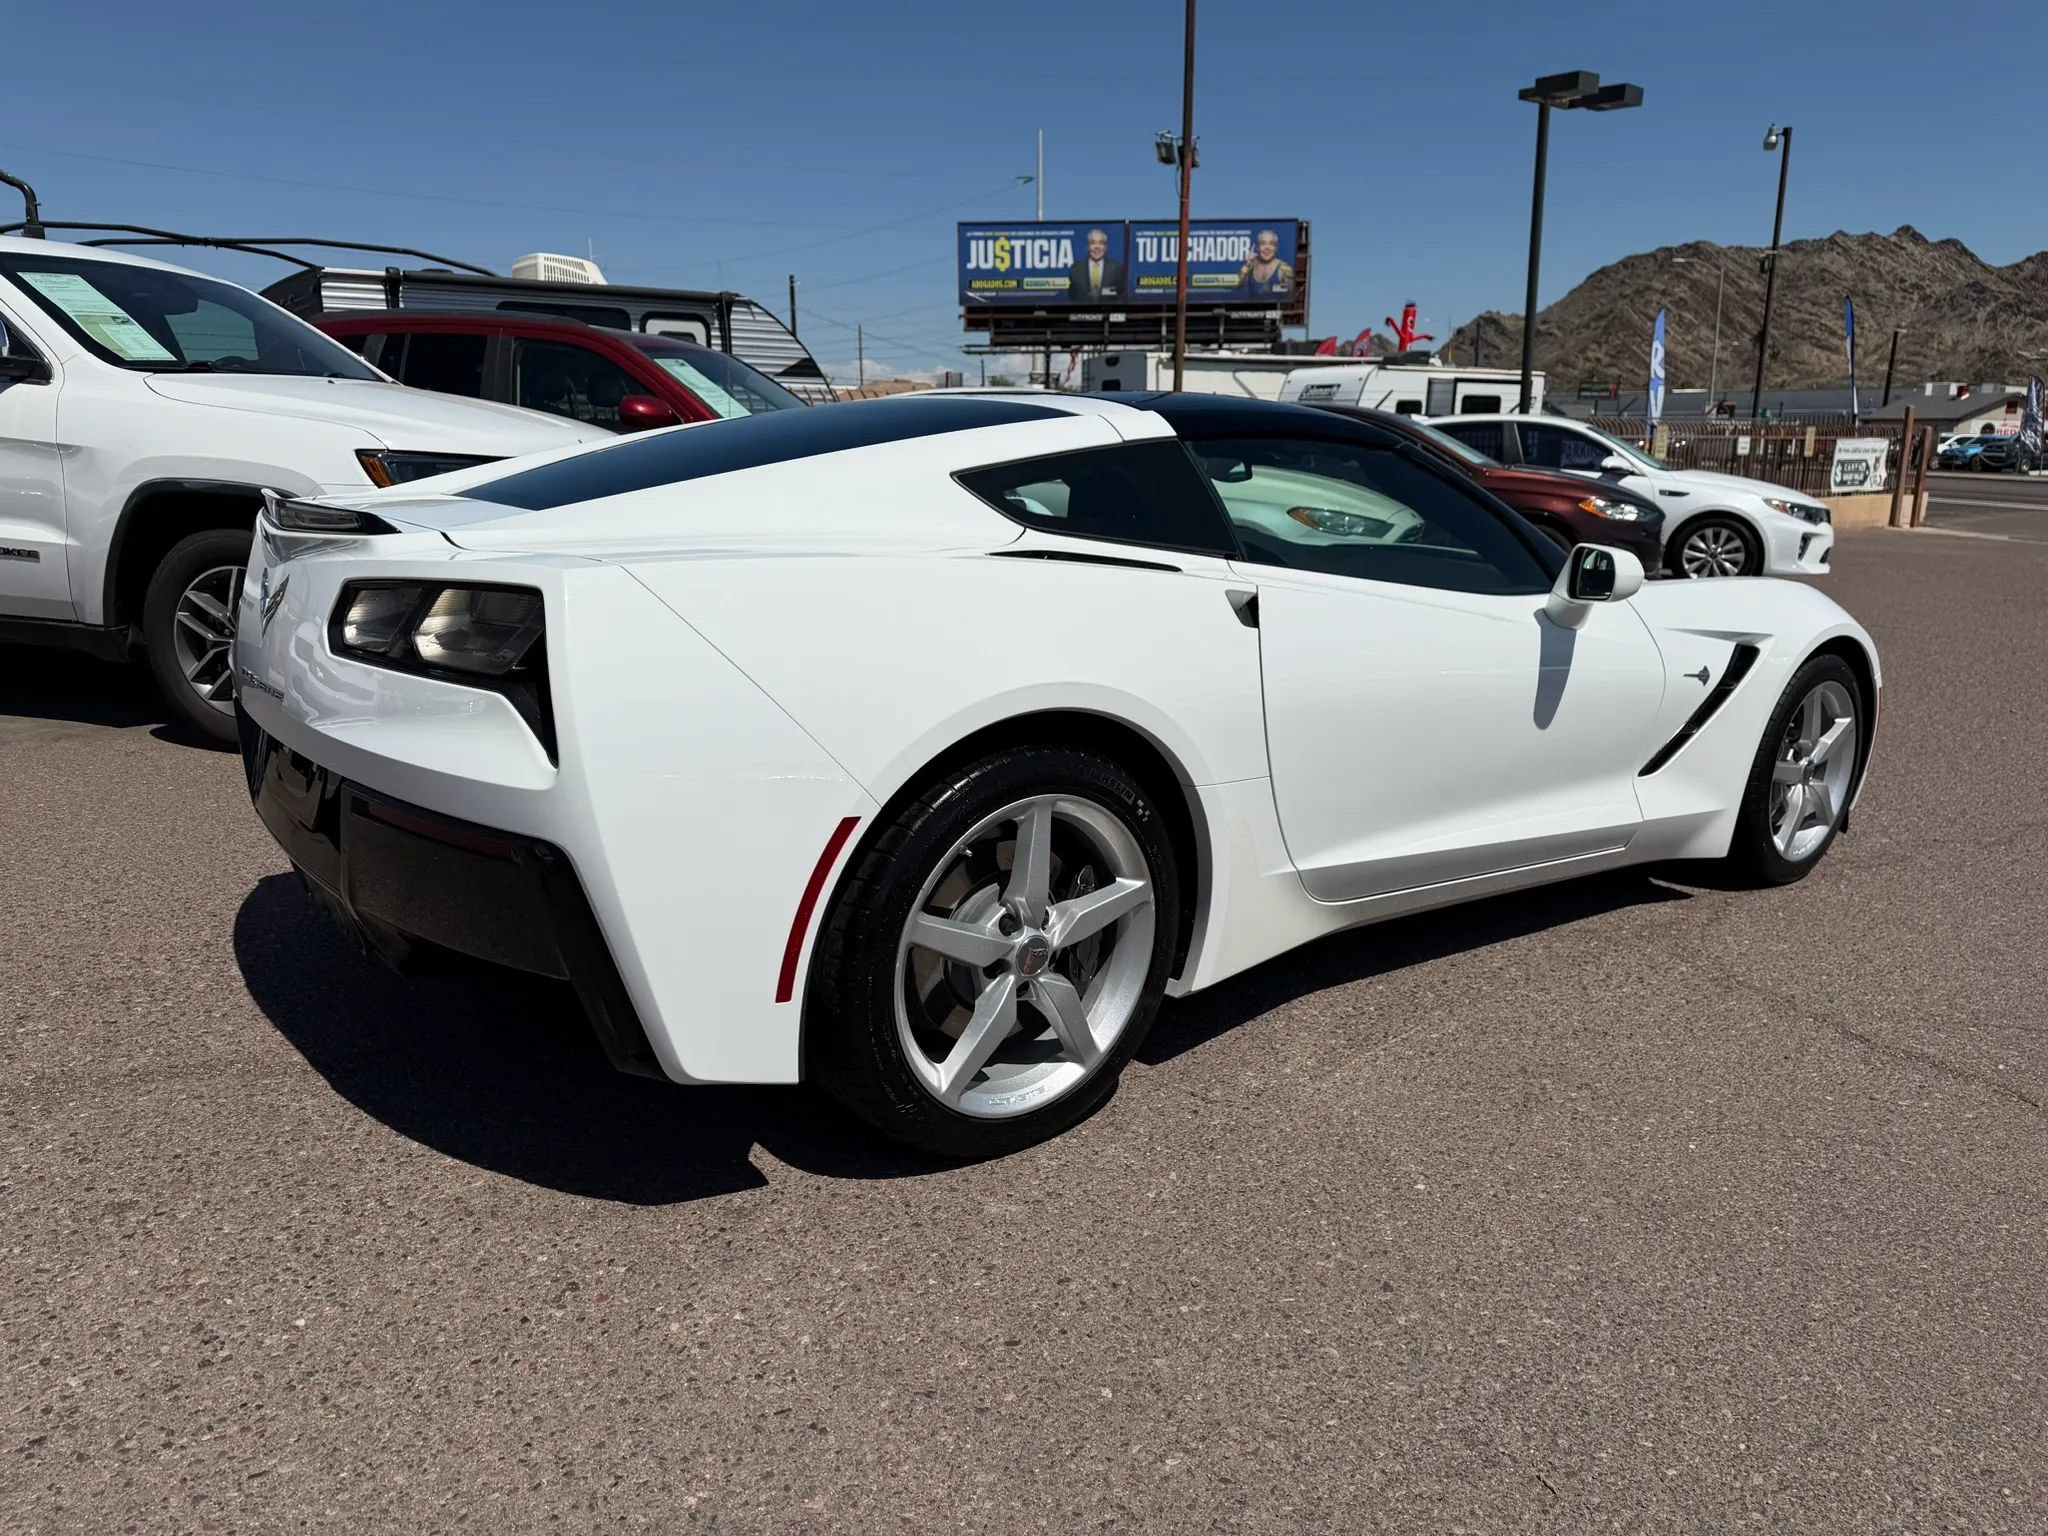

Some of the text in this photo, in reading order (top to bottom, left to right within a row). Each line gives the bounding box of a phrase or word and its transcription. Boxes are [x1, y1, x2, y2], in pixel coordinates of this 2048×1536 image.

[966, 236, 1075, 272] JU$TICIA
[1136, 236, 1251, 262] TU LUCHADOR
